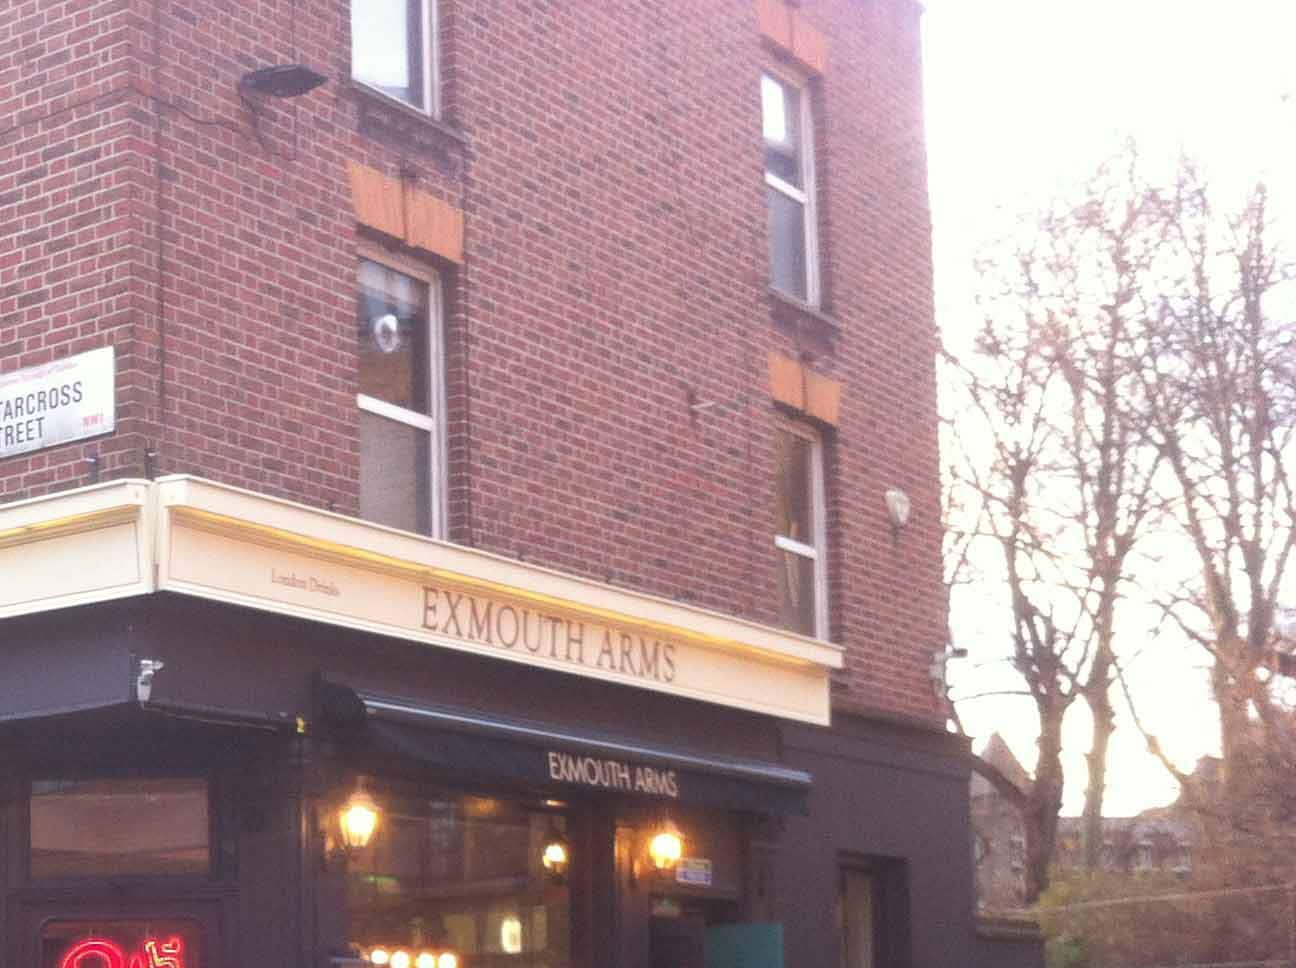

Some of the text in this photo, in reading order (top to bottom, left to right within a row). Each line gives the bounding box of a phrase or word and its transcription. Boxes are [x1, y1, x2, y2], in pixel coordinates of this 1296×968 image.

[420, 586, 677, 683] EXMOUTH ARMS
[548, 751, 679, 798] EXMOUTH ARMS
